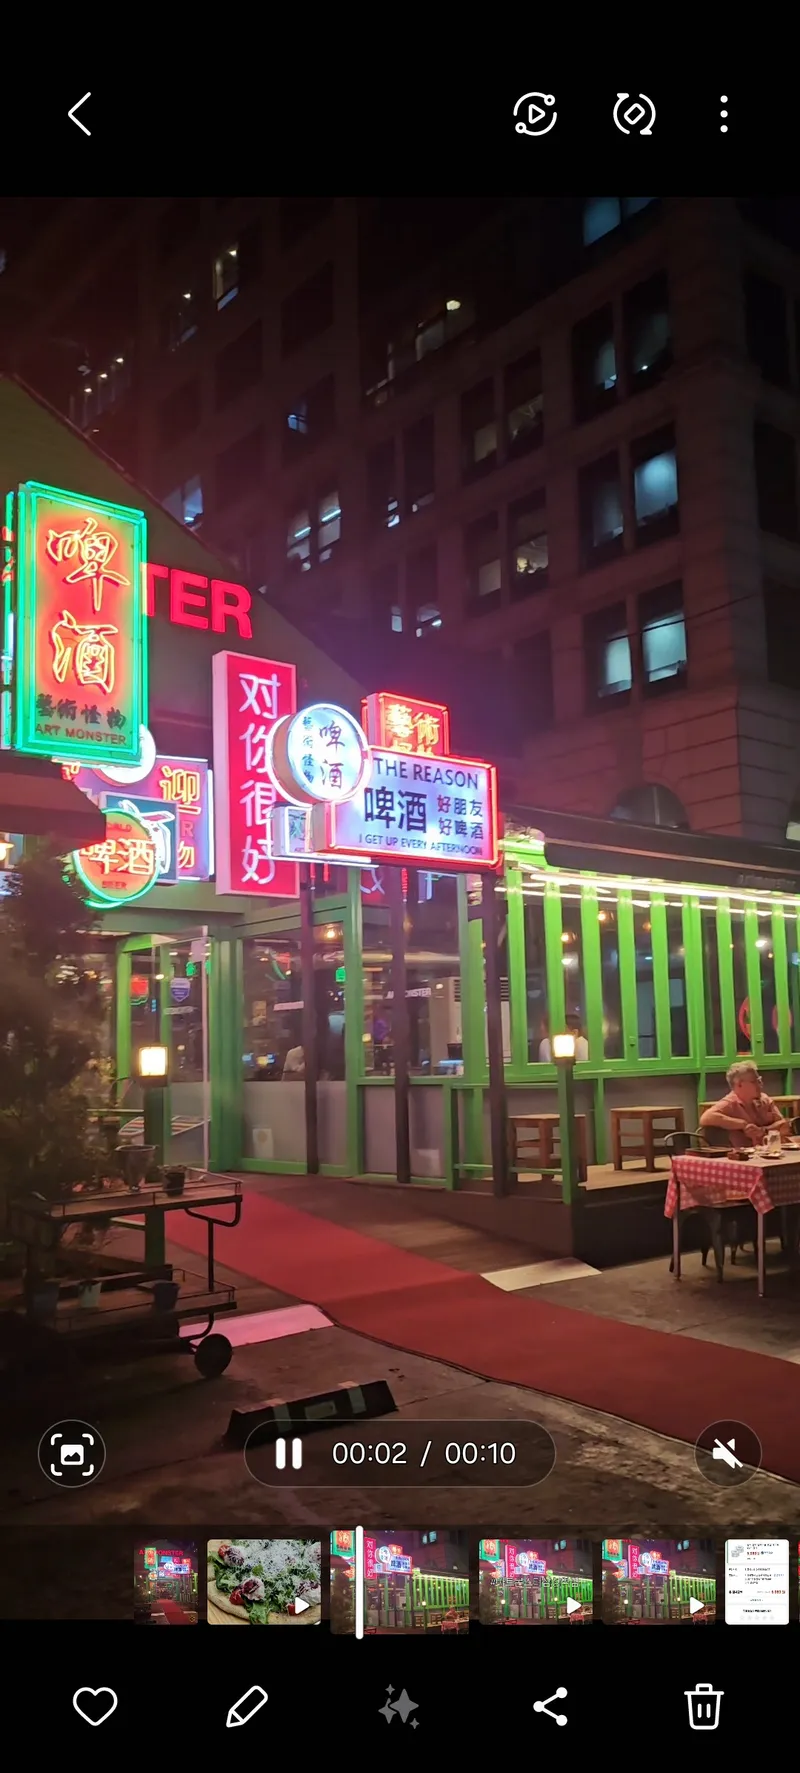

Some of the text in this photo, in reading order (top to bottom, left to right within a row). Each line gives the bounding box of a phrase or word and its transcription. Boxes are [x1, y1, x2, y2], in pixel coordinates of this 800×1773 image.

[47, 517, 130, 692] 啤酒
[35, 723, 126, 745] ART MONSTER
[319, 720, 346, 789] 啤酒
[239, 673, 281, 885] 对你很好
[373, 757, 479, 790] THE REASON
[364, 786, 427, 833] 啤酒
[436, 794, 484, 817] 好朋友
[365, 834, 384, 845] GET
[385, 836, 398, 847] UP
[401, 837, 427, 850] EVERY
[430, 841, 483, 856] AFTERNOON
[438, 817, 484, 840] 好啤酒
[80, 838, 154, 876] 啤酒
